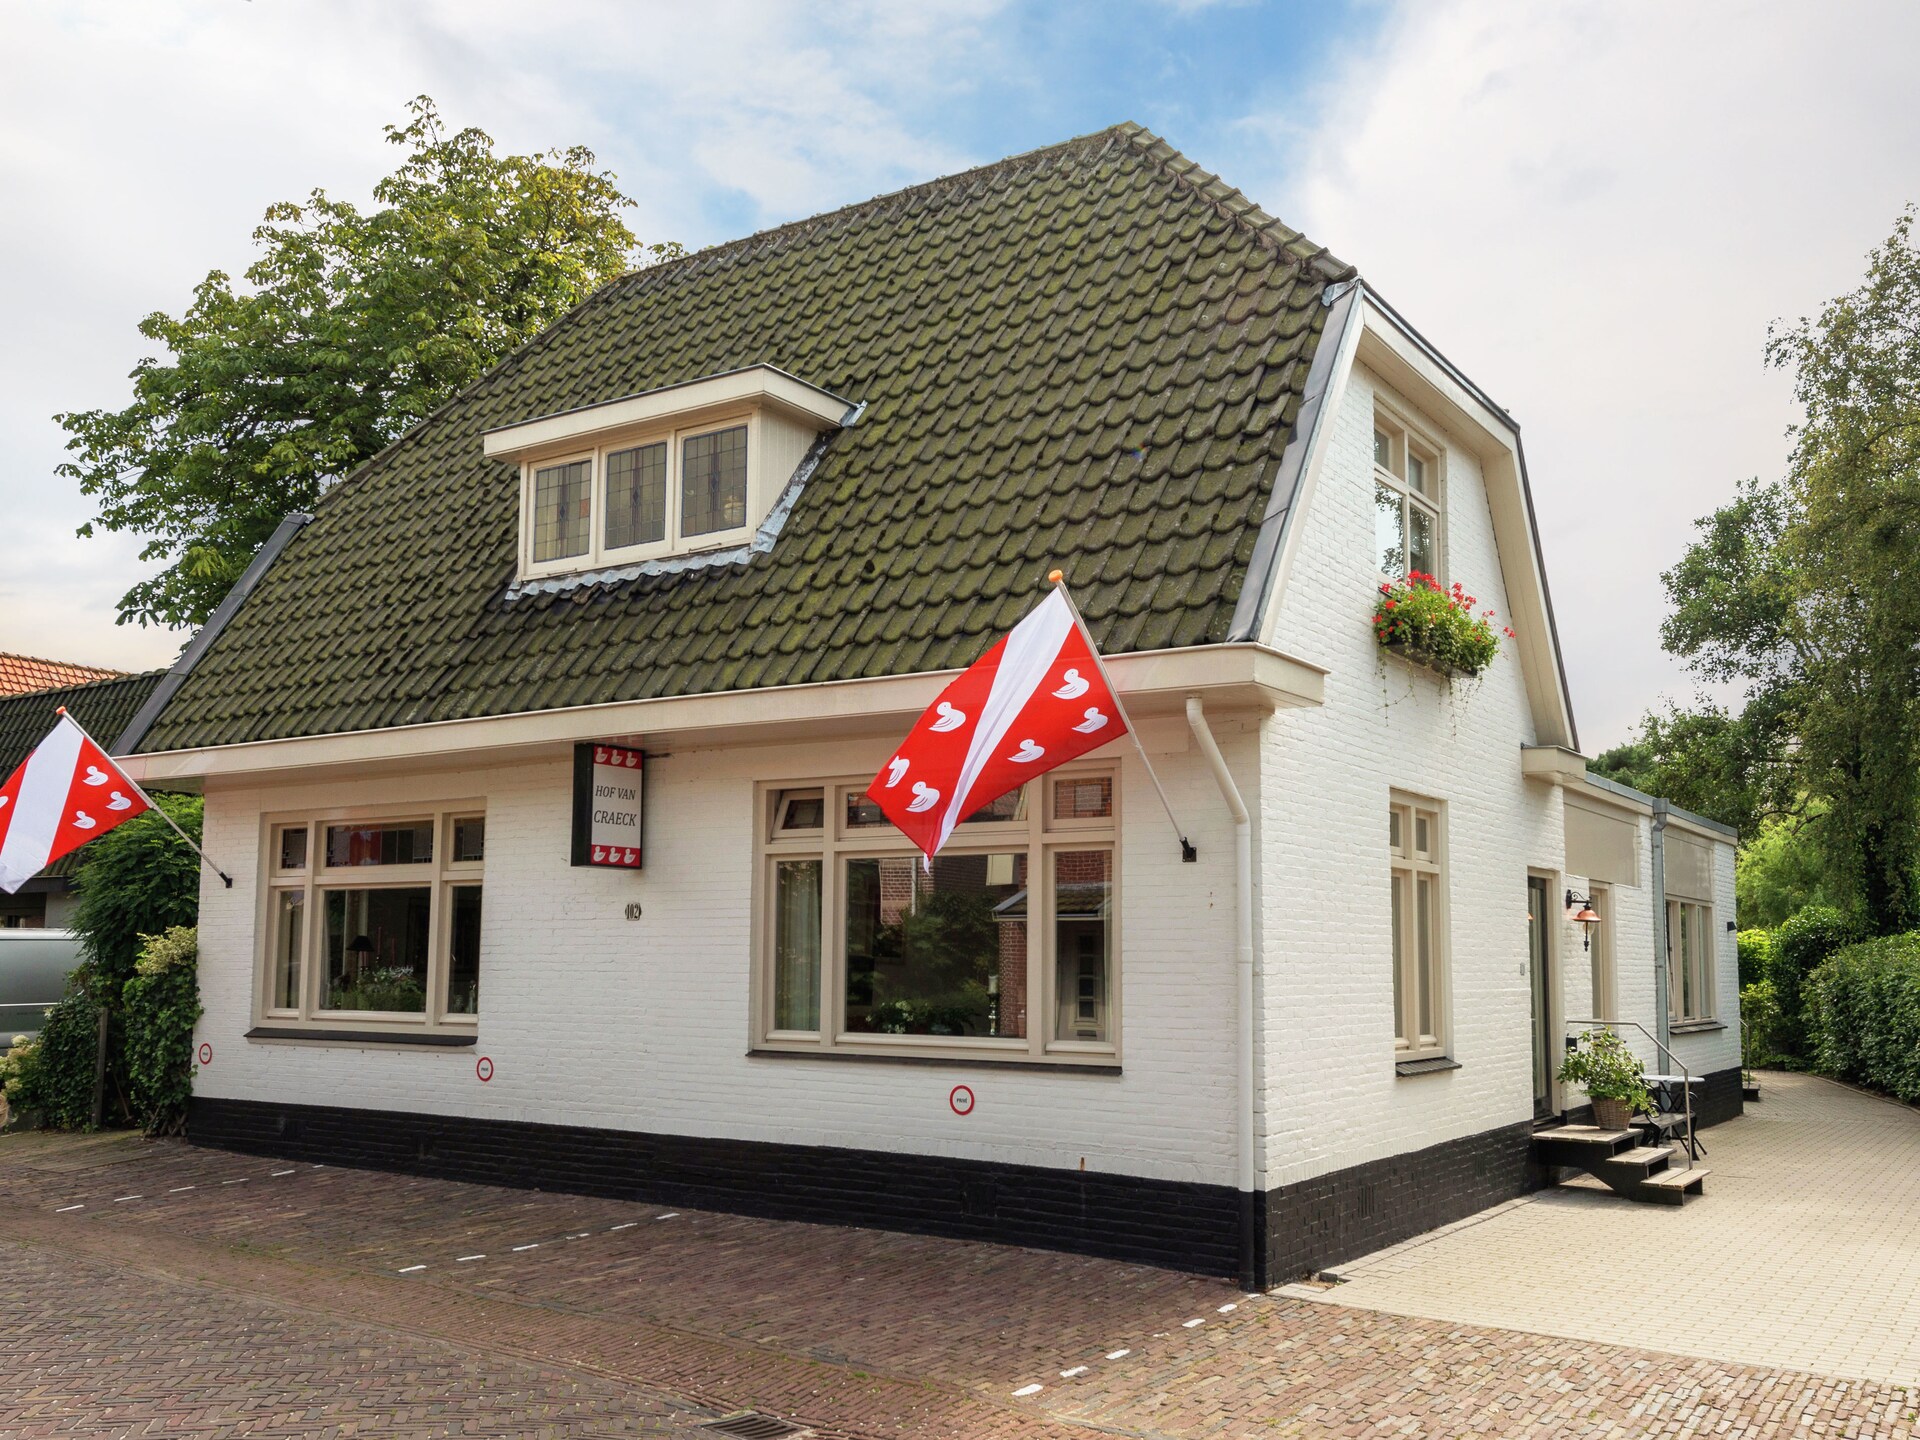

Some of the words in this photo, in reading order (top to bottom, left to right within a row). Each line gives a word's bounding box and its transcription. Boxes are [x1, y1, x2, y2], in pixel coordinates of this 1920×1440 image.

[595, 785, 616, 798] HOF
[618, 787, 636, 800] VAN
[593, 809, 637, 827] CRAECK
[626, 903, 640, 919] 102
